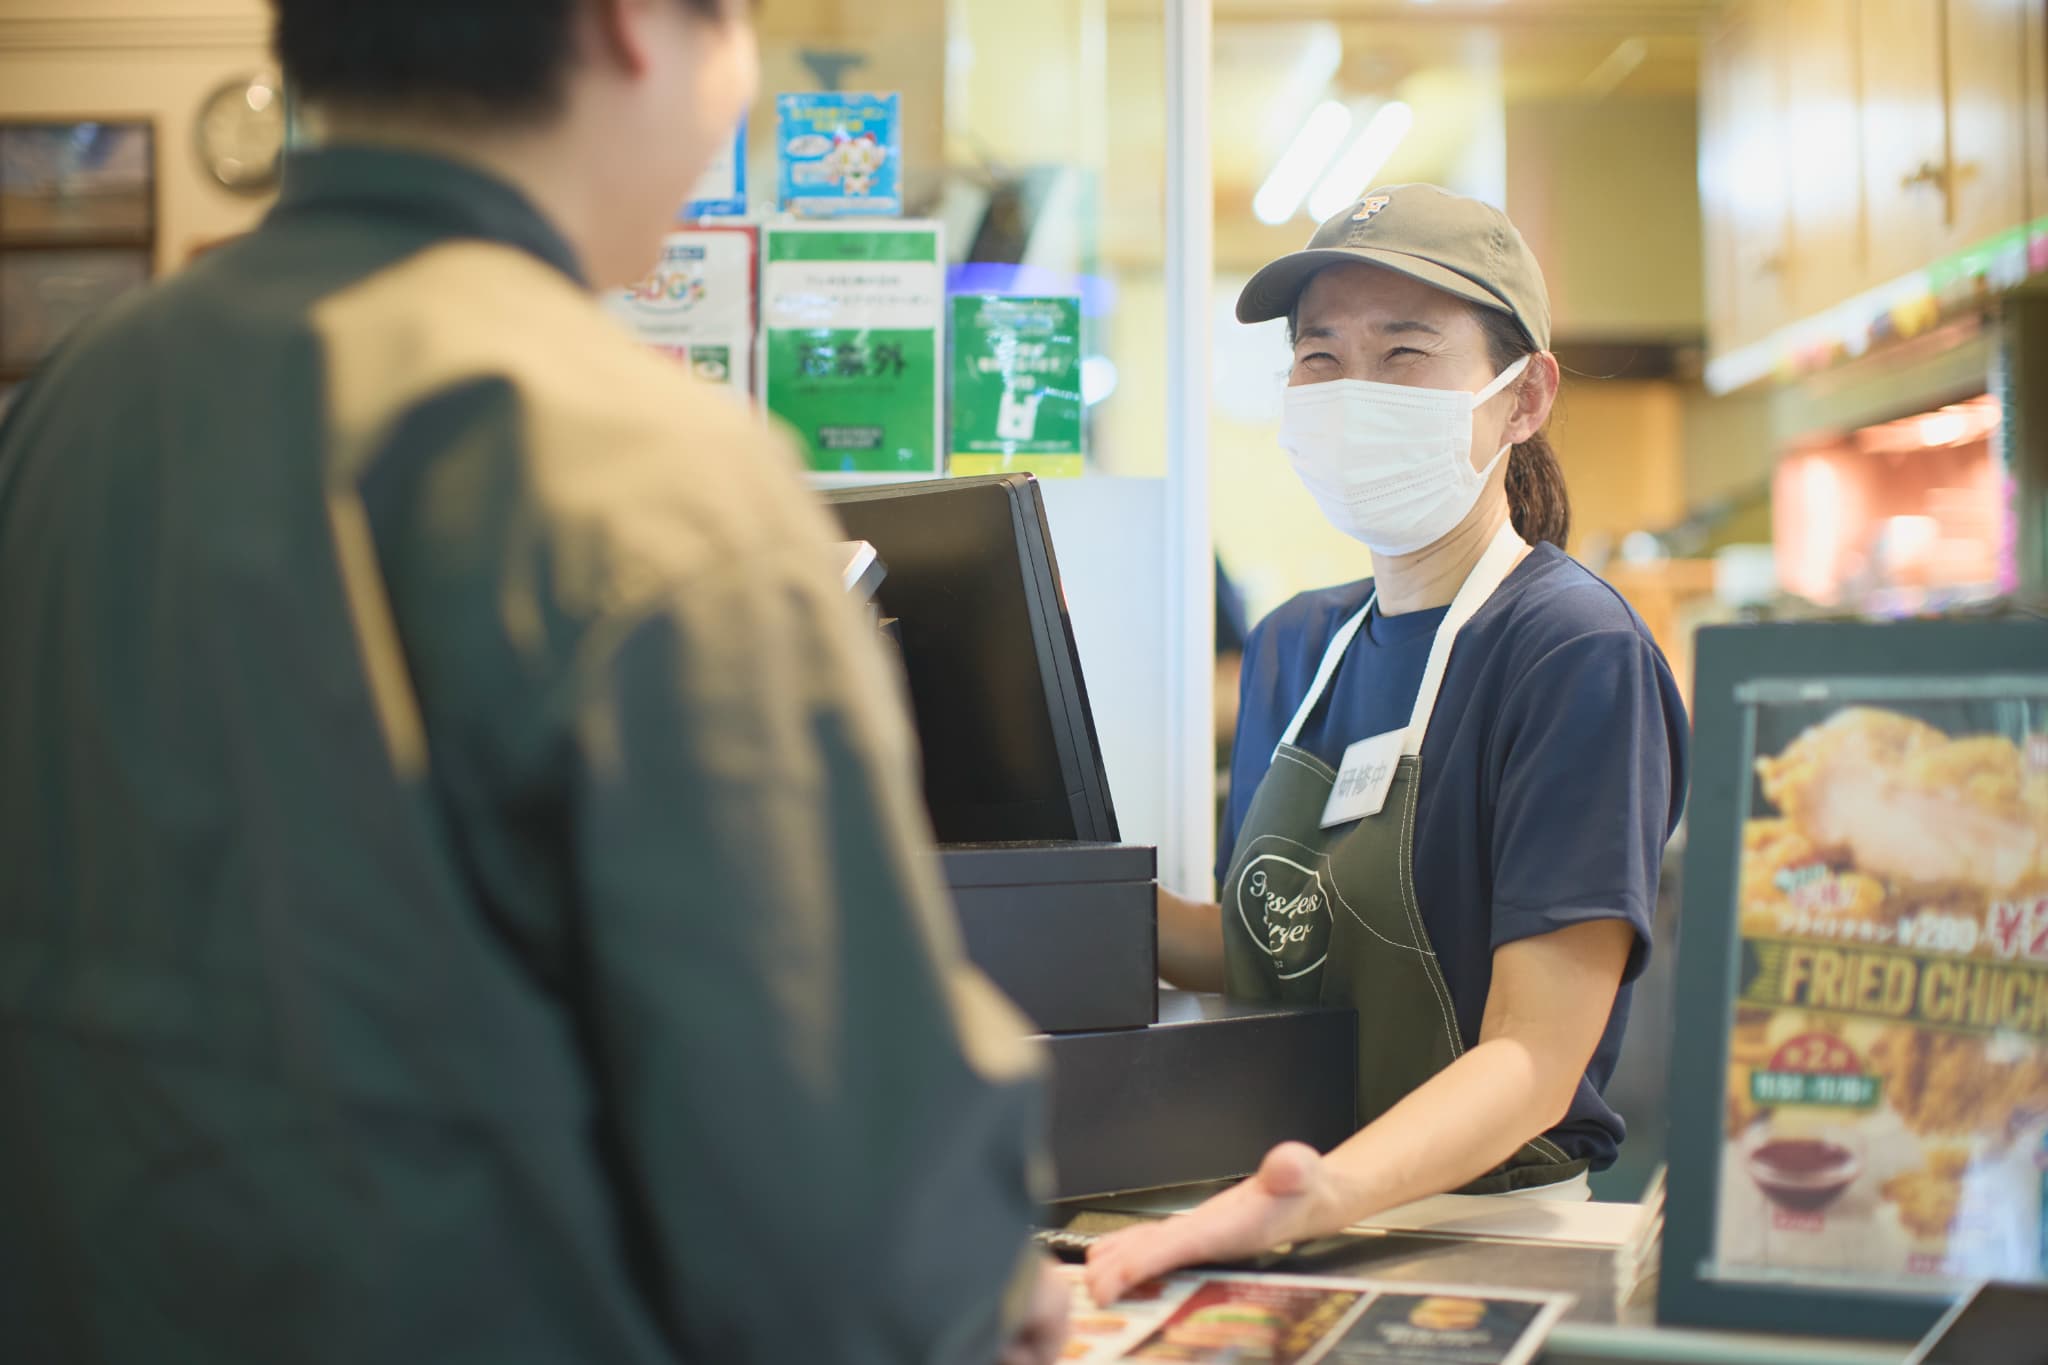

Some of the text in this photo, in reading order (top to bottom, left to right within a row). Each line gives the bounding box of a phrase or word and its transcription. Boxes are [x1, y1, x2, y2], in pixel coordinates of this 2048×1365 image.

[1352, 196, 1389, 221] F
[1338, 764, 1386, 797] 研修中
[1783, 946, 1917, 1017] FRIED
